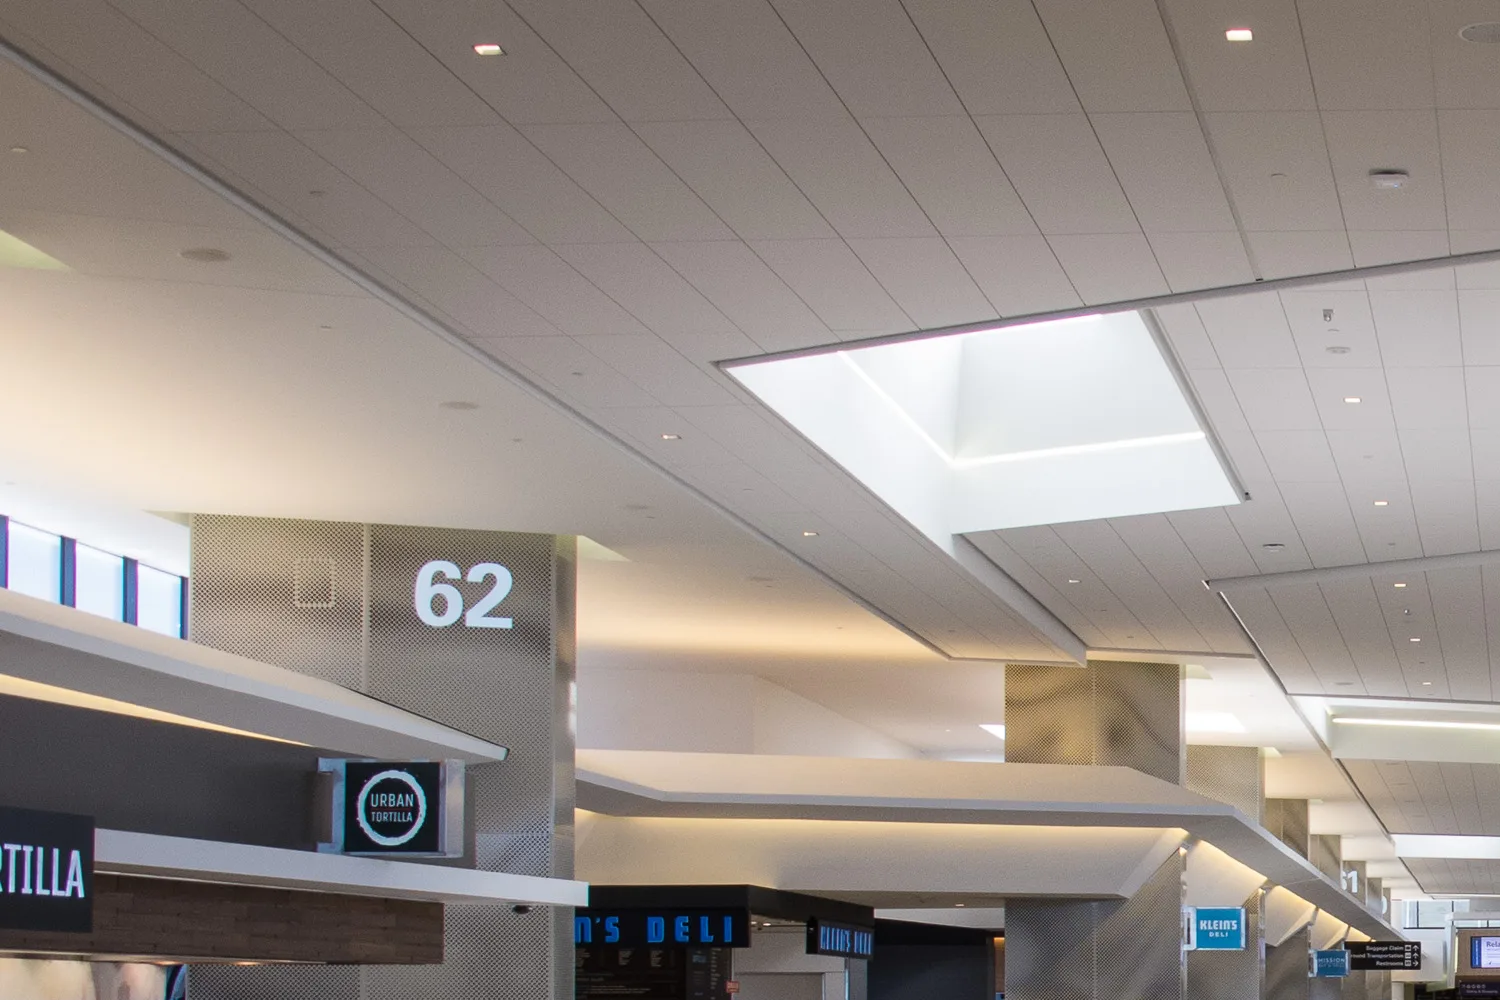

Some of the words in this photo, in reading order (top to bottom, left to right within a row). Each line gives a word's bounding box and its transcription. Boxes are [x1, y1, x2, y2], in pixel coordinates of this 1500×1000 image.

[415, 560, 513, 629] 62
[371, 793, 414, 808] URBAN
[371, 811, 413, 823] TORTILLA
[0, 843, 85, 898] TILLA
[647, 916, 733, 943] DELI
[1200, 920, 1238, 930] KLEIN'S
